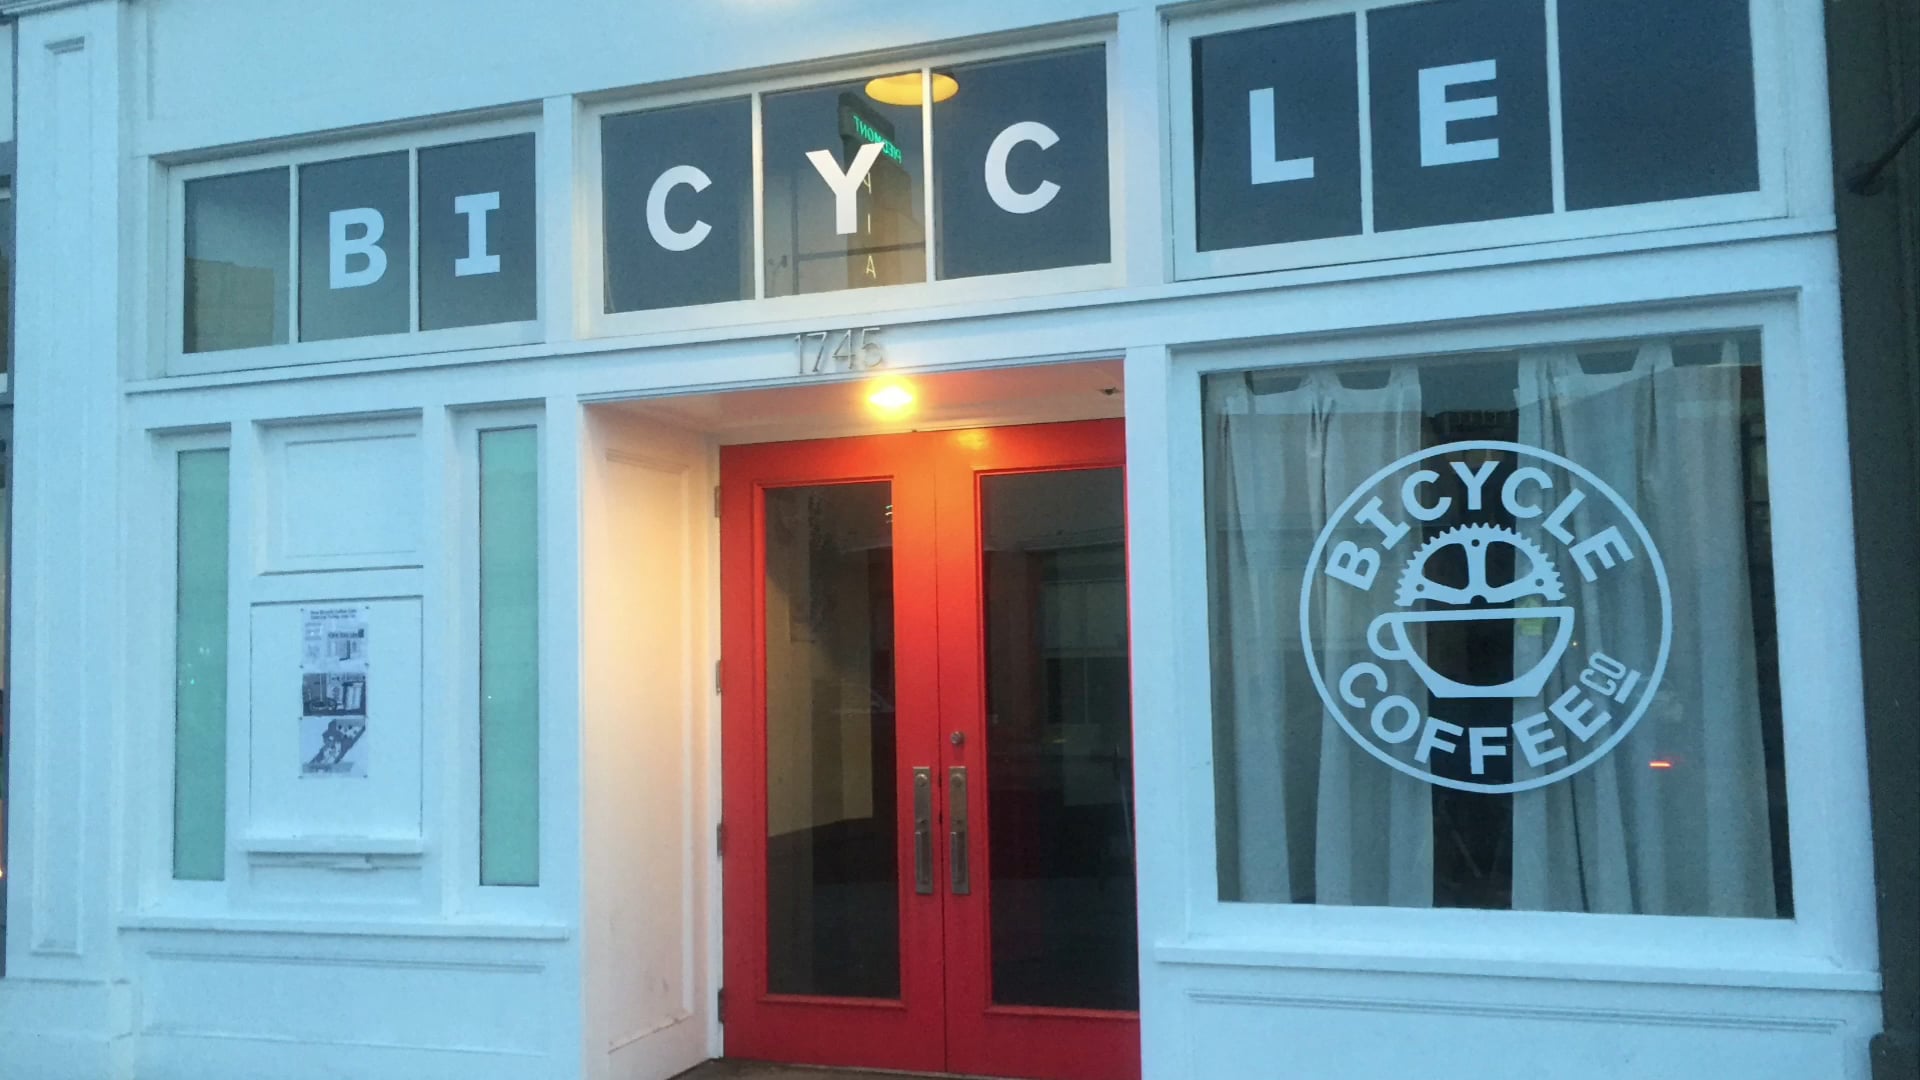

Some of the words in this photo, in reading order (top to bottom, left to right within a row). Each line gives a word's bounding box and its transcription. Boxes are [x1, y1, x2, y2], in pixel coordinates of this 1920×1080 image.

[329, 59, 1500, 290] BICYCLE
[794, 327, 884, 374] 1745
[1324, 460, 1635, 592] BICYCLE
[1339, 661, 1612, 775] COFFEE
[1579, 651, 1629, 698] CO
